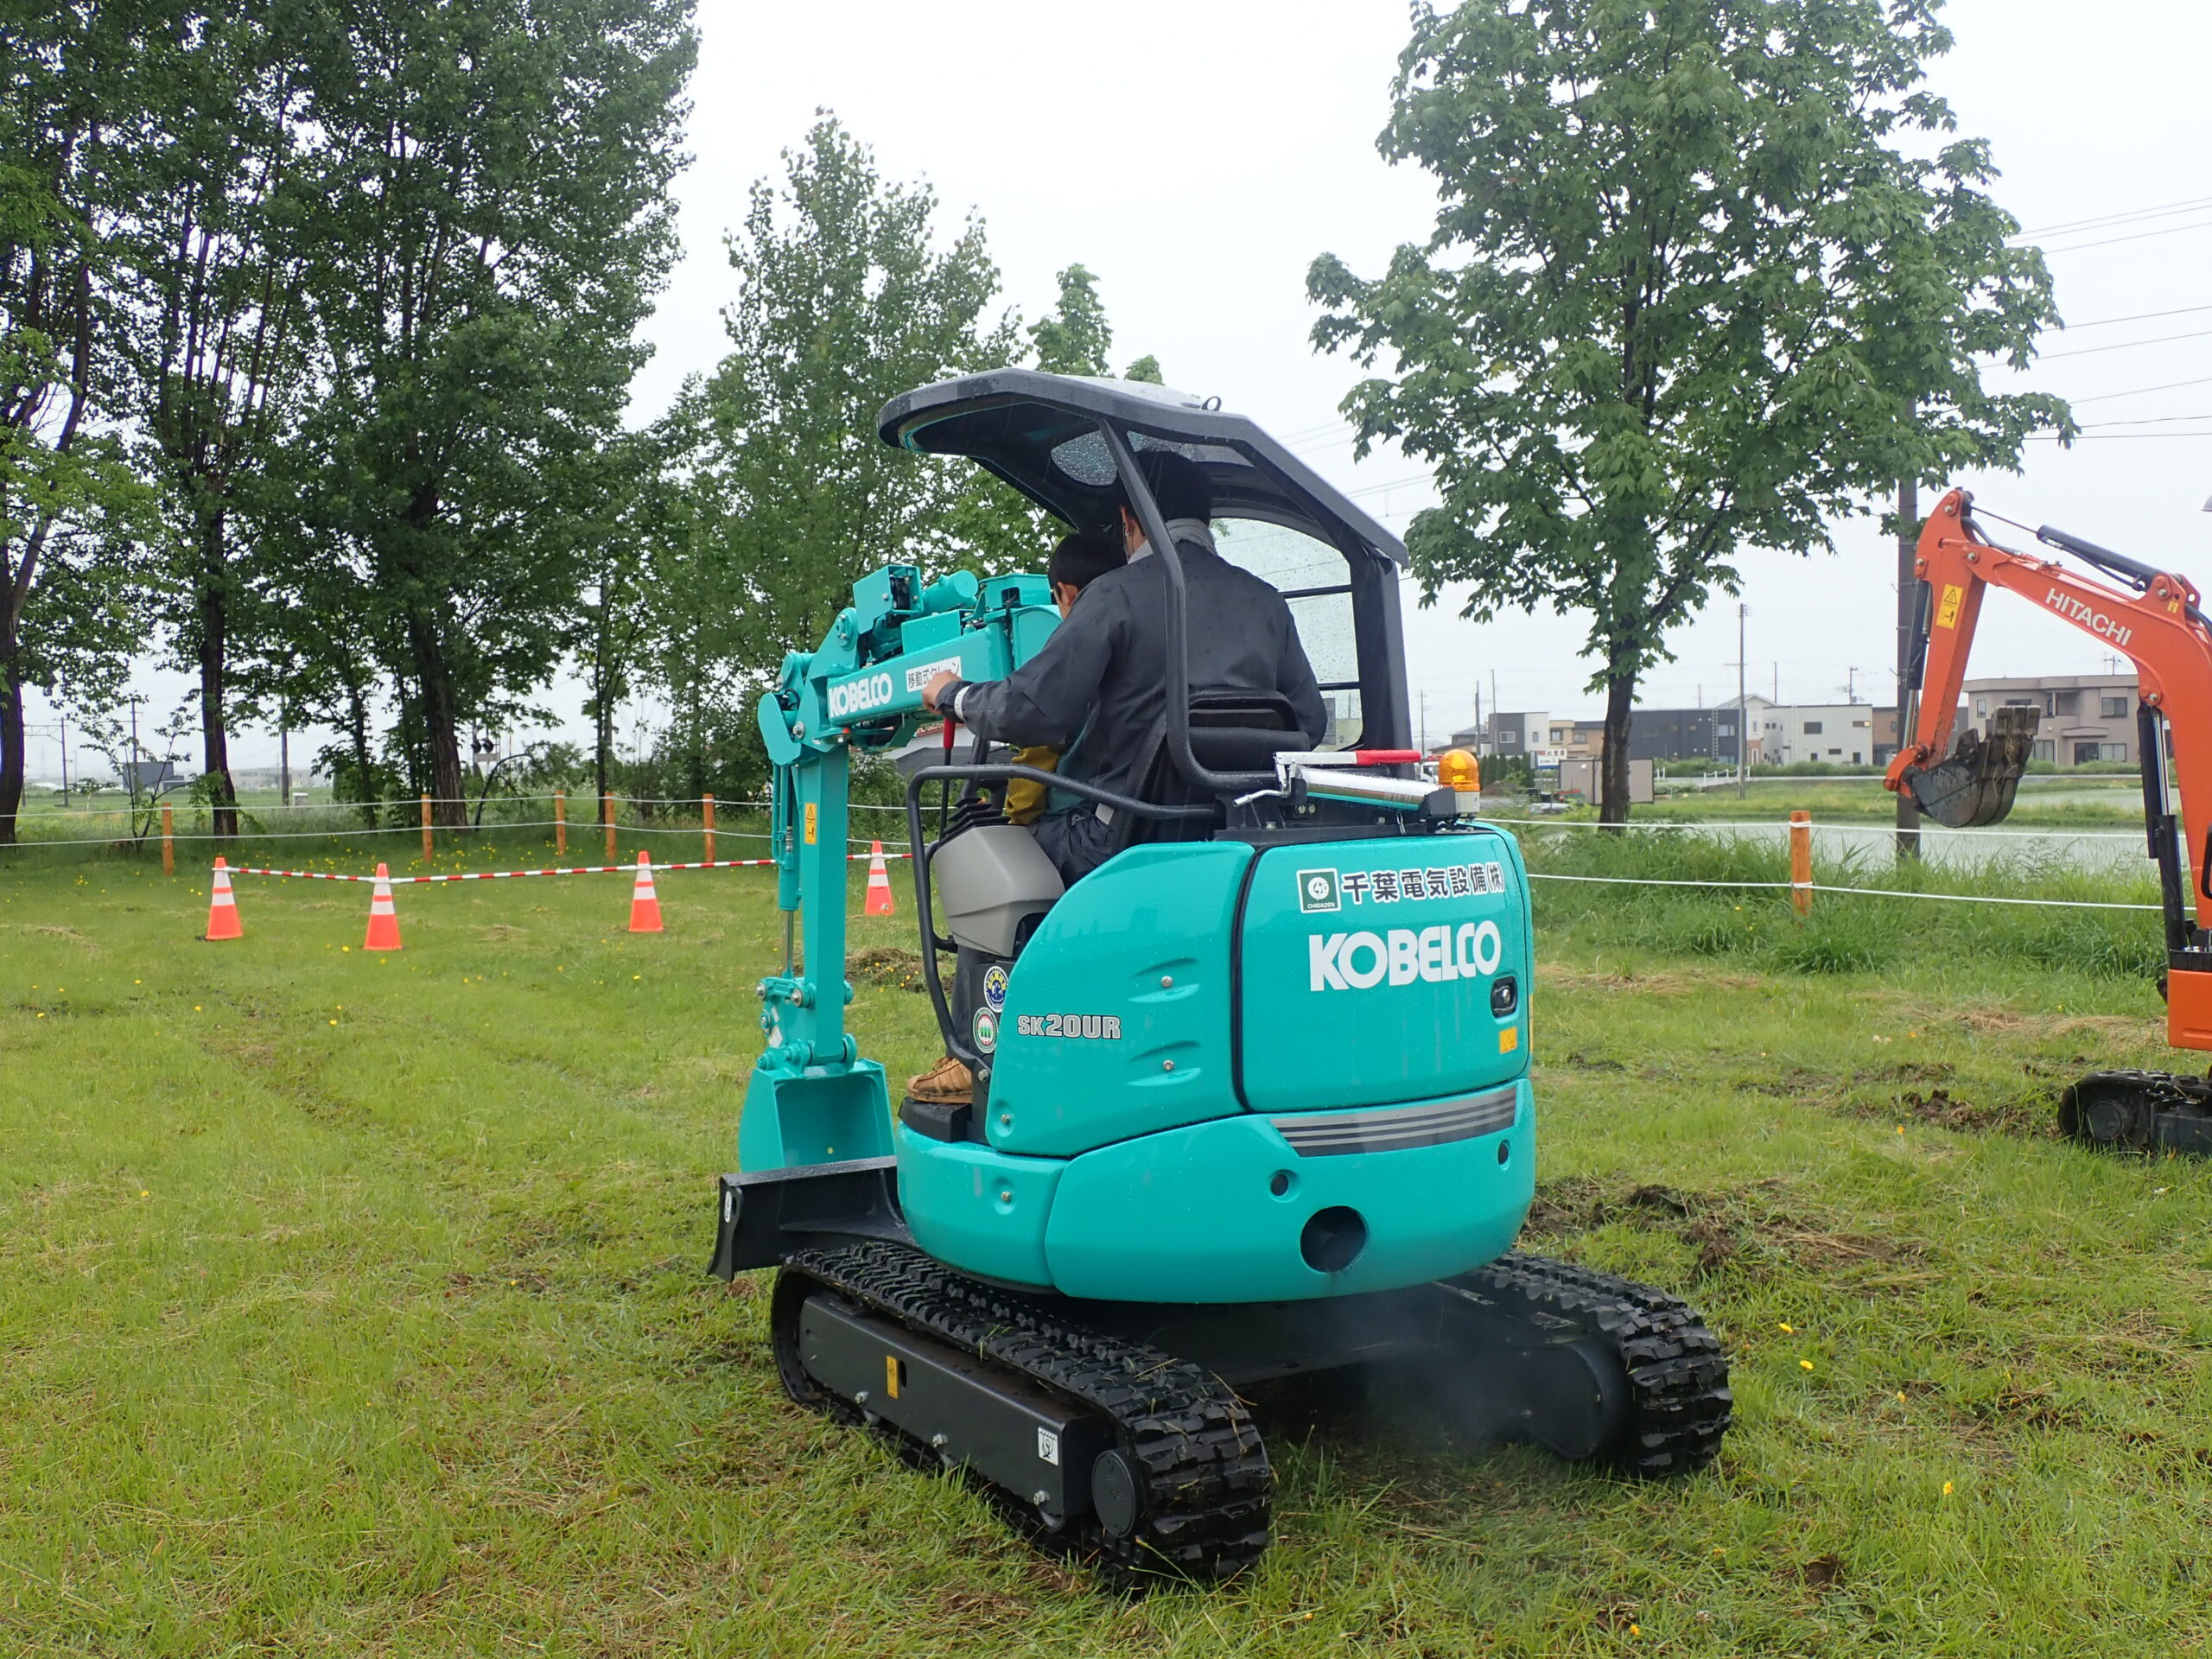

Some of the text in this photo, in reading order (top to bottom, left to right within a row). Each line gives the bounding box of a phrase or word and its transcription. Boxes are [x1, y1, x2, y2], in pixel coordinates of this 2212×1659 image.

[2045, 588, 2133, 646] HITACHI
[829, 673, 893, 718] KOBELCO
[1343, 863, 1505, 903] 千葉電気設備(株)
[1309, 920, 1502, 991] KOBELCO
[1017, 1013, 1122, 1039] SK20UR
